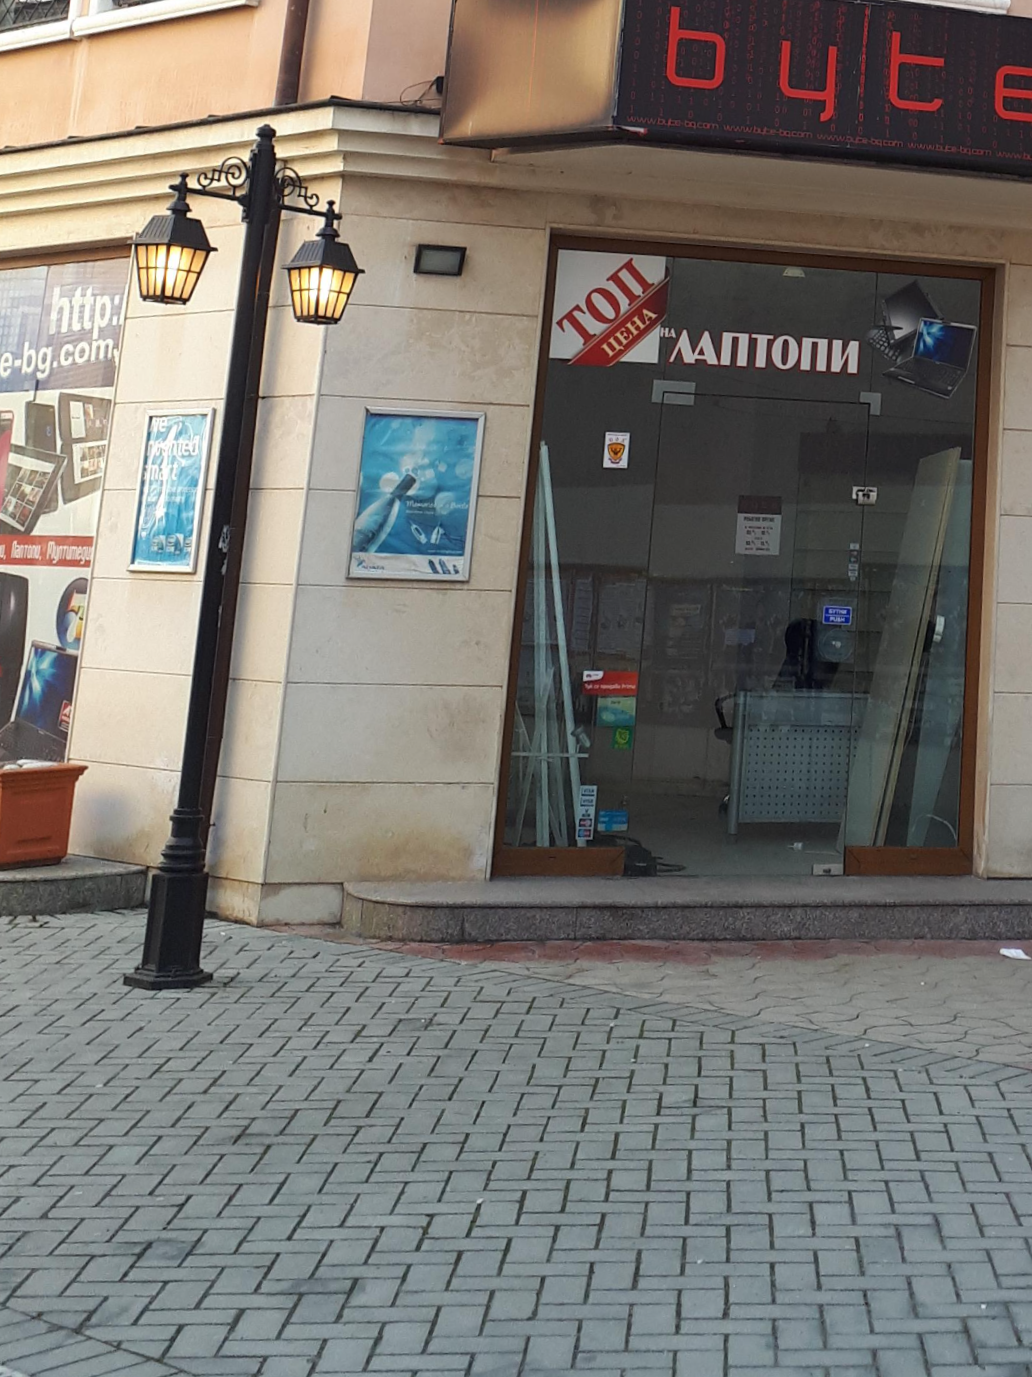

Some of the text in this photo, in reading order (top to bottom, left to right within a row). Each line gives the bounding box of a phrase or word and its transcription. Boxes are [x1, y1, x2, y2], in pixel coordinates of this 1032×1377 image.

[627, 115, 719, 131] www.byte-bg.com
[723, 124, 813, 139] www.byte-bg.com
[817, 133, 903, 148] www.byte-bg.com
[907, 141, 992, 157] www.byte-bg.com
[555, 257, 656, 347] ТОП
[600, 308, 658, 358] ЦЕНА
[660, 327, 861, 374] НА ЛАПТОПИ
